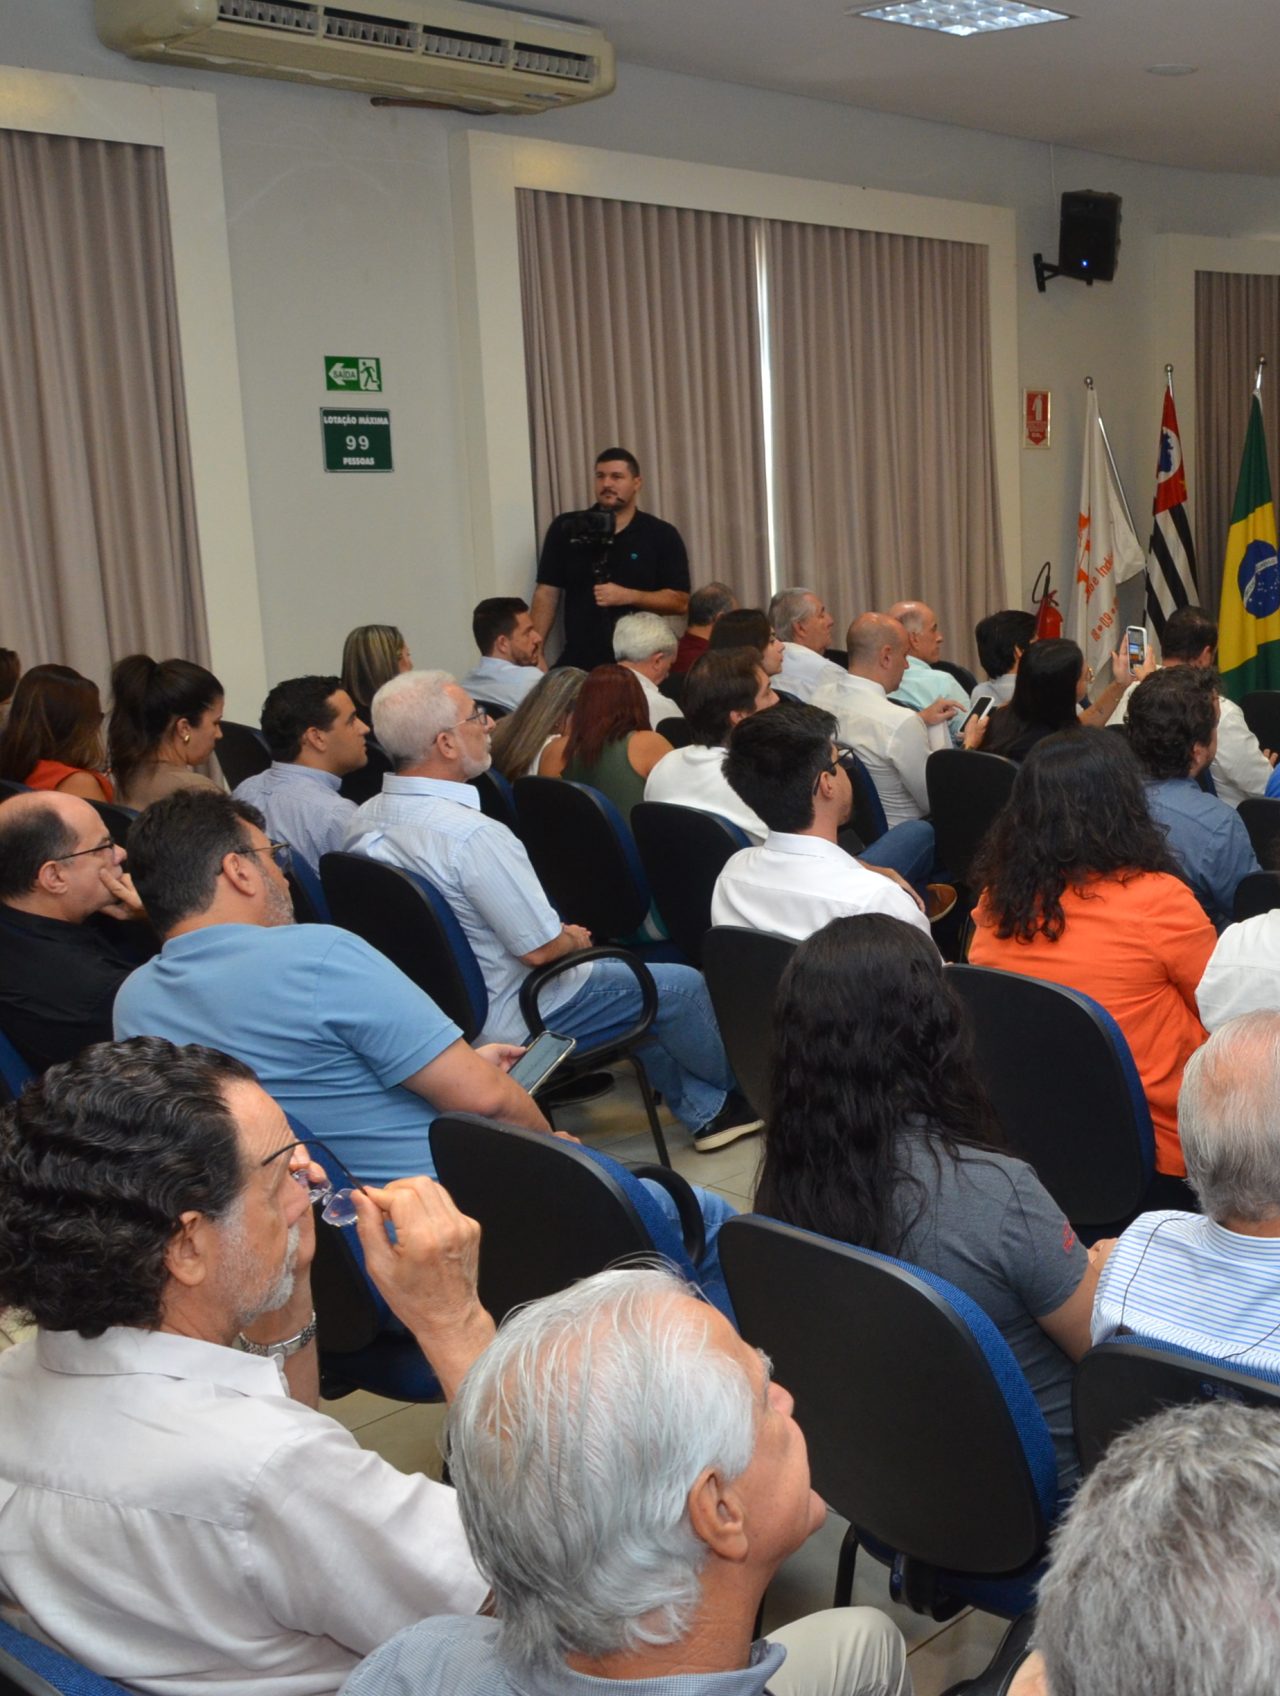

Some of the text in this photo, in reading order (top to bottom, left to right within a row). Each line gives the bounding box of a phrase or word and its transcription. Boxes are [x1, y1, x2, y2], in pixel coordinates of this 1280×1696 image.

[333, 368, 356, 379] SAÍDA
[324, 415, 389, 426] LOTAÇÃO MÁXIMA
[345, 435, 370, 451] 99
[342, 457, 375, 465] PESSOAS
